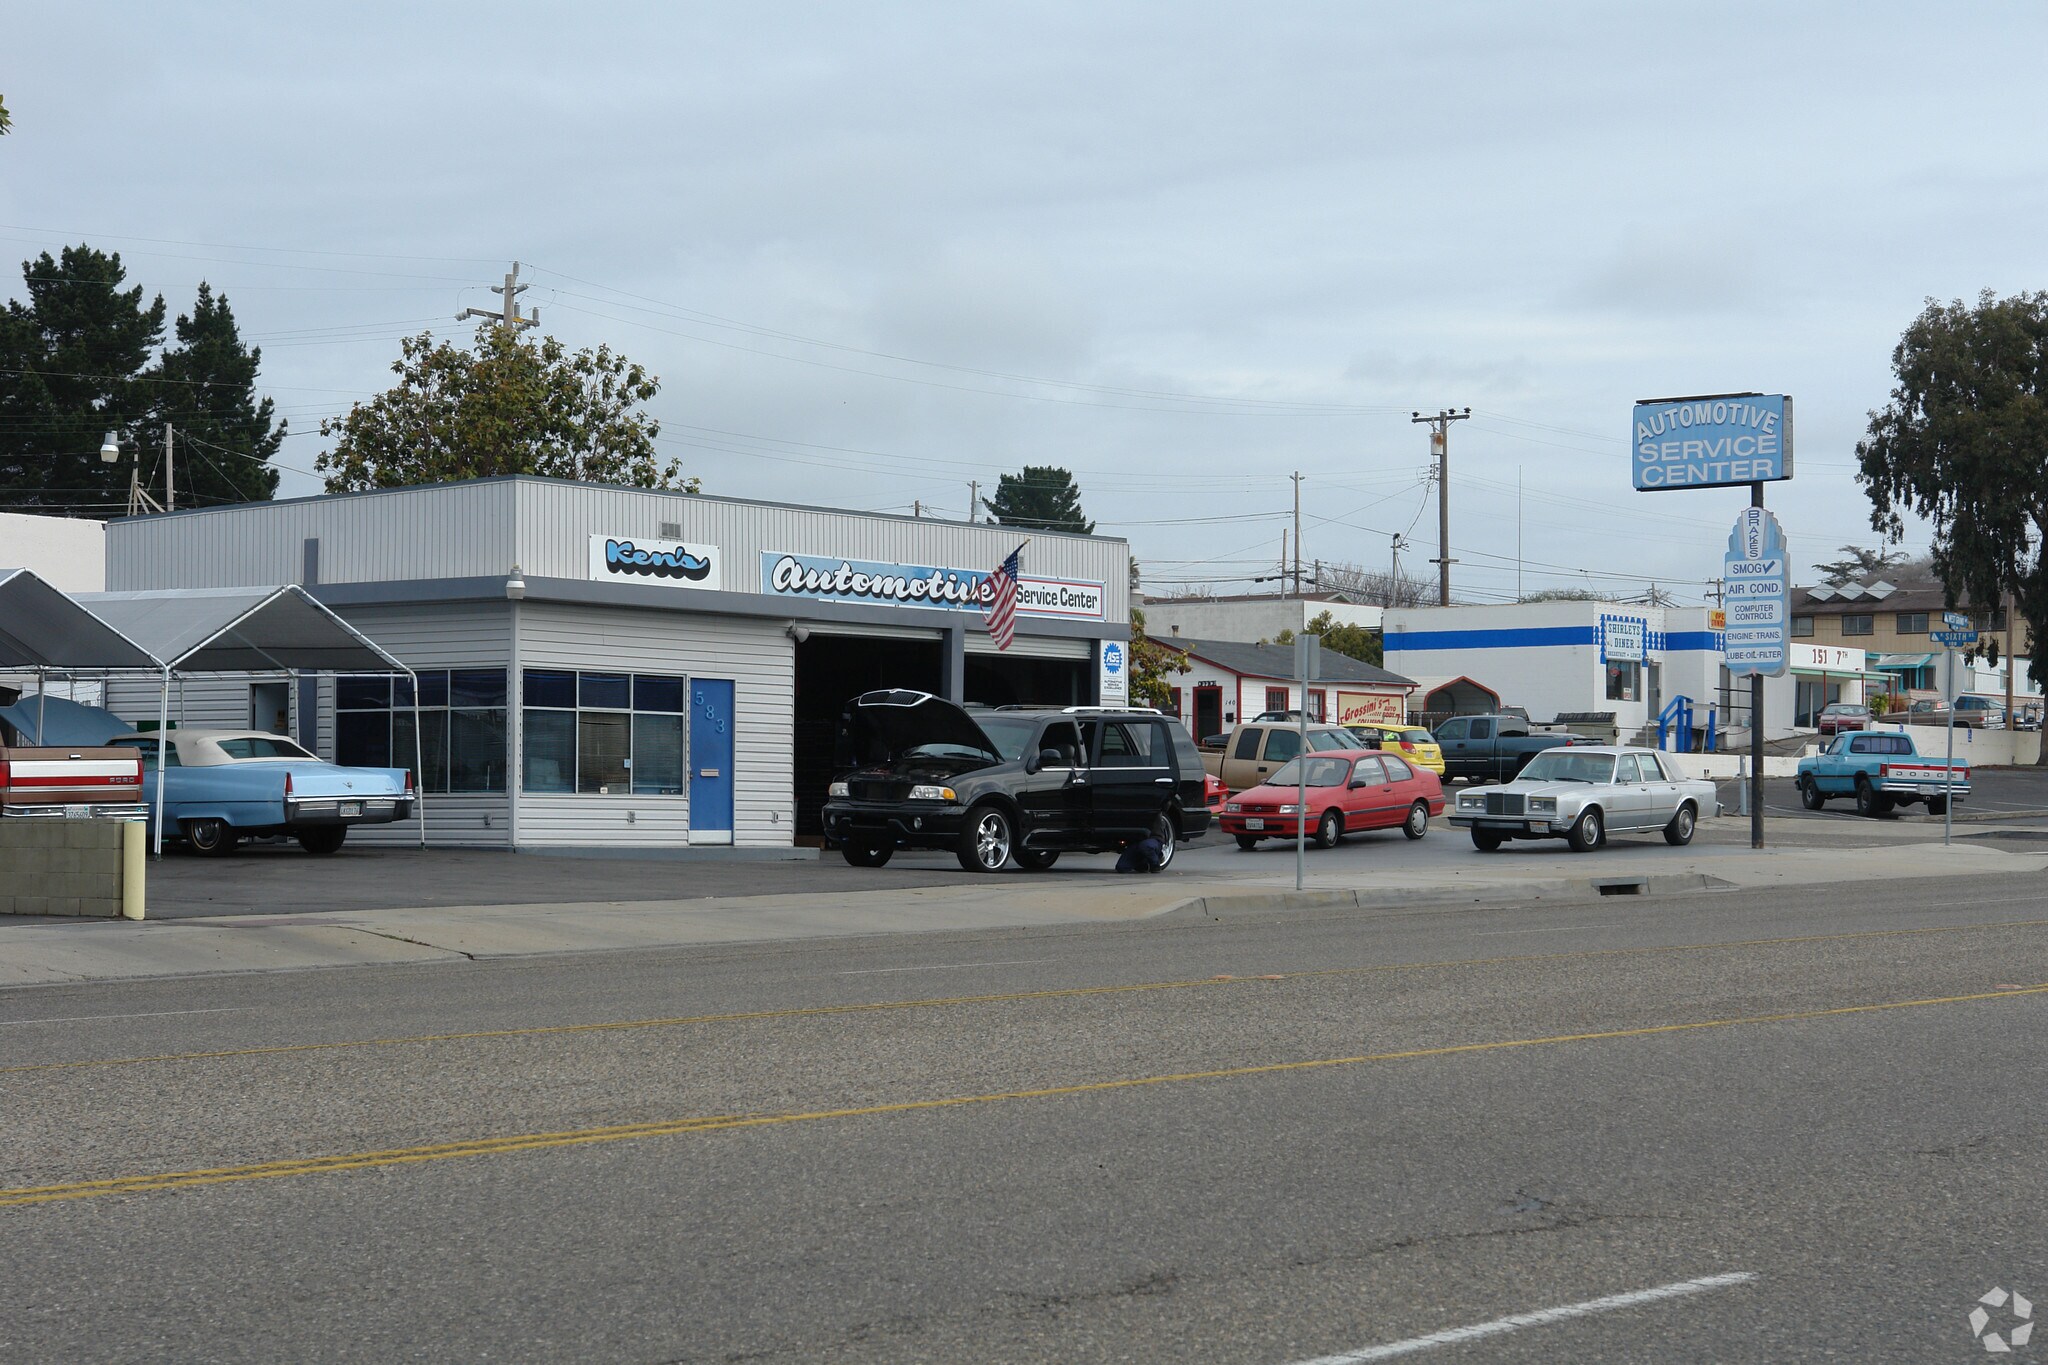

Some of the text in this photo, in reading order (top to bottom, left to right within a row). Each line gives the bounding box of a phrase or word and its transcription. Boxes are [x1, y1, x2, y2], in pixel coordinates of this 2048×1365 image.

[1637, 402, 1779, 444] AUTOMOTIVE
[1638, 434, 1777, 463] SERVICE
[1641, 458, 1773, 486] CENTER
[1748, 510, 1760, 558] BRAKES
[605, 539, 710, 580] Ken's
[1733, 563, 1762, 575] SMOG
[1728, 583, 1781, 595] AIR COND.
[1016, 584, 1097, 609] Service Center
[1735, 604, 1773, 613] COMPUTER
[1735, 612, 1773, 621] CONTROLS
[1608, 623, 1641, 636] SHIRLEYS
[1945, 632, 1967, 641] SIXTH
[1614, 638, 1635, 649] DINER
[1105, 651, 1120, 663] ASE
[1812, 648, 1827, 664] 151
[1344, 697, 1383, 721] Grossini's
[1896, 771, 1957, 779] DODGE
